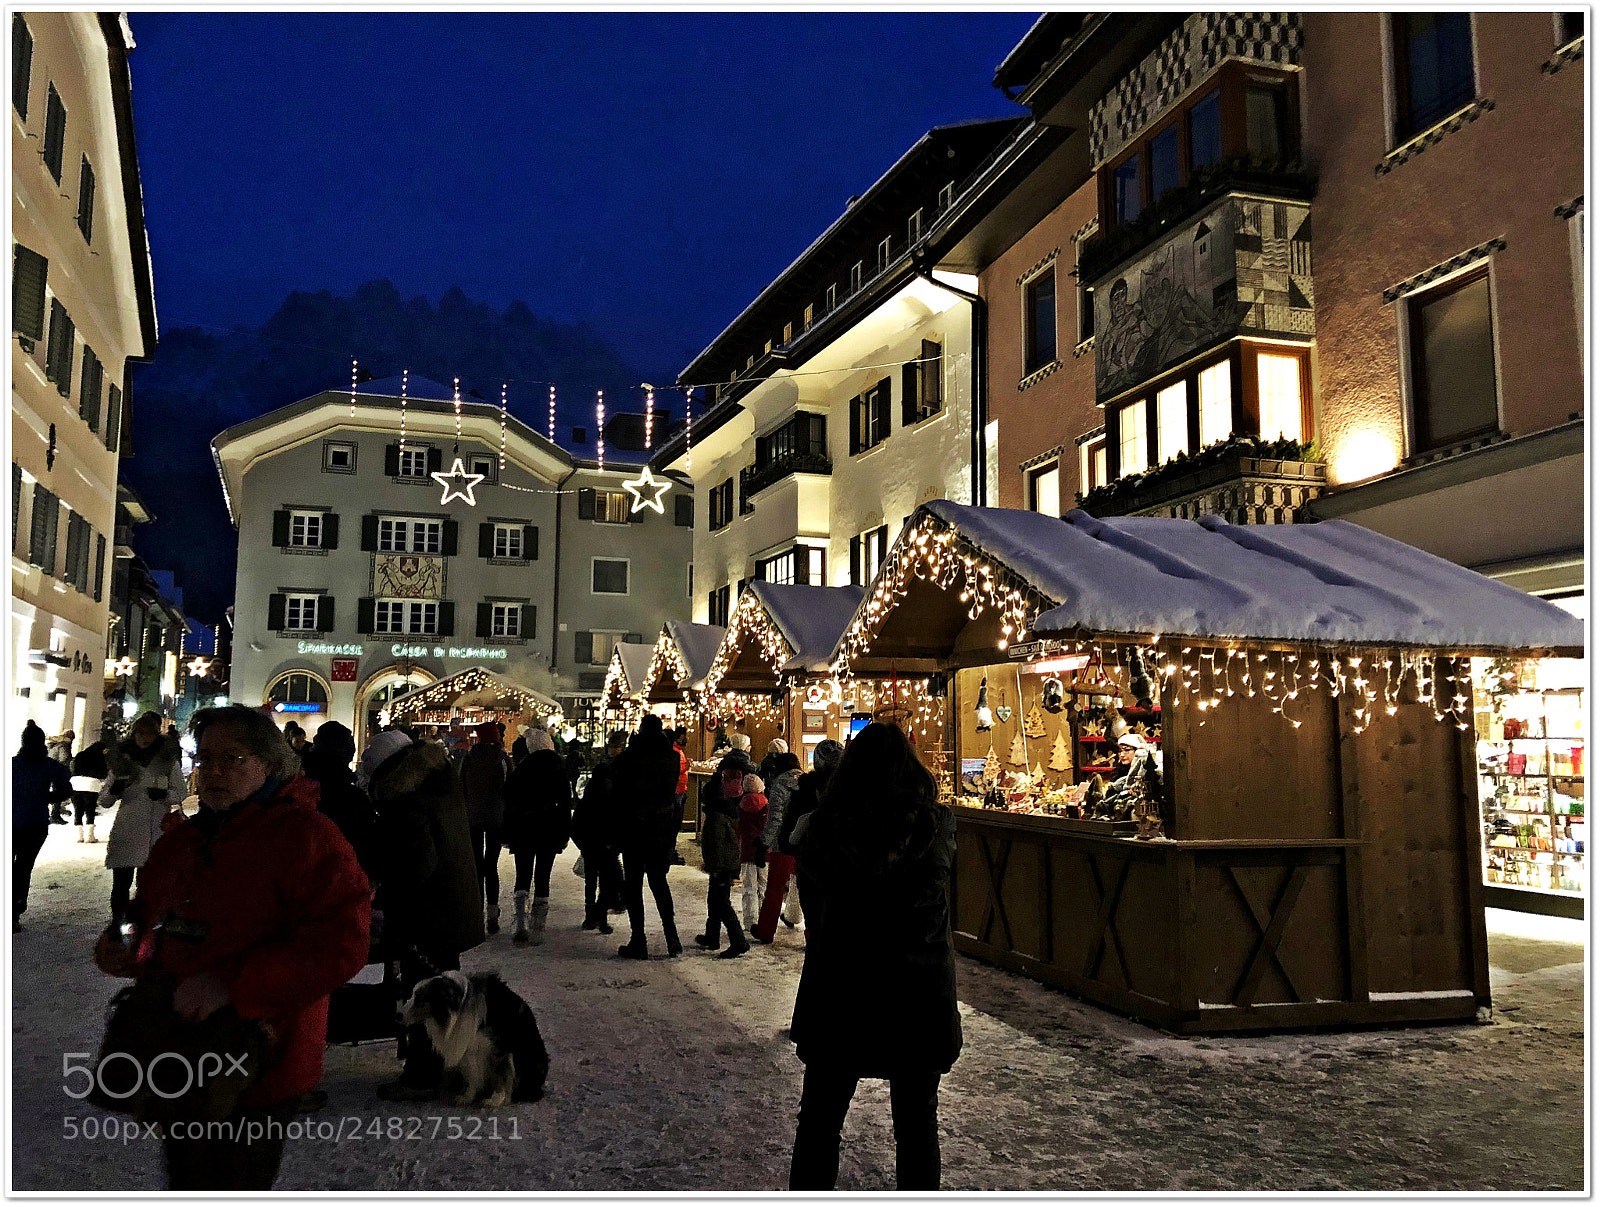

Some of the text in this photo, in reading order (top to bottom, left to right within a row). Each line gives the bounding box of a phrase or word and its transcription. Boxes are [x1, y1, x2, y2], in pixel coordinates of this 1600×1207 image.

[297, 640, 363, 656] SPARKASSE
[391, 643, 428, 657] CASSA
[433, 646, 446, 658] DI
[283, 703, 319, 712] BANCOMAT
